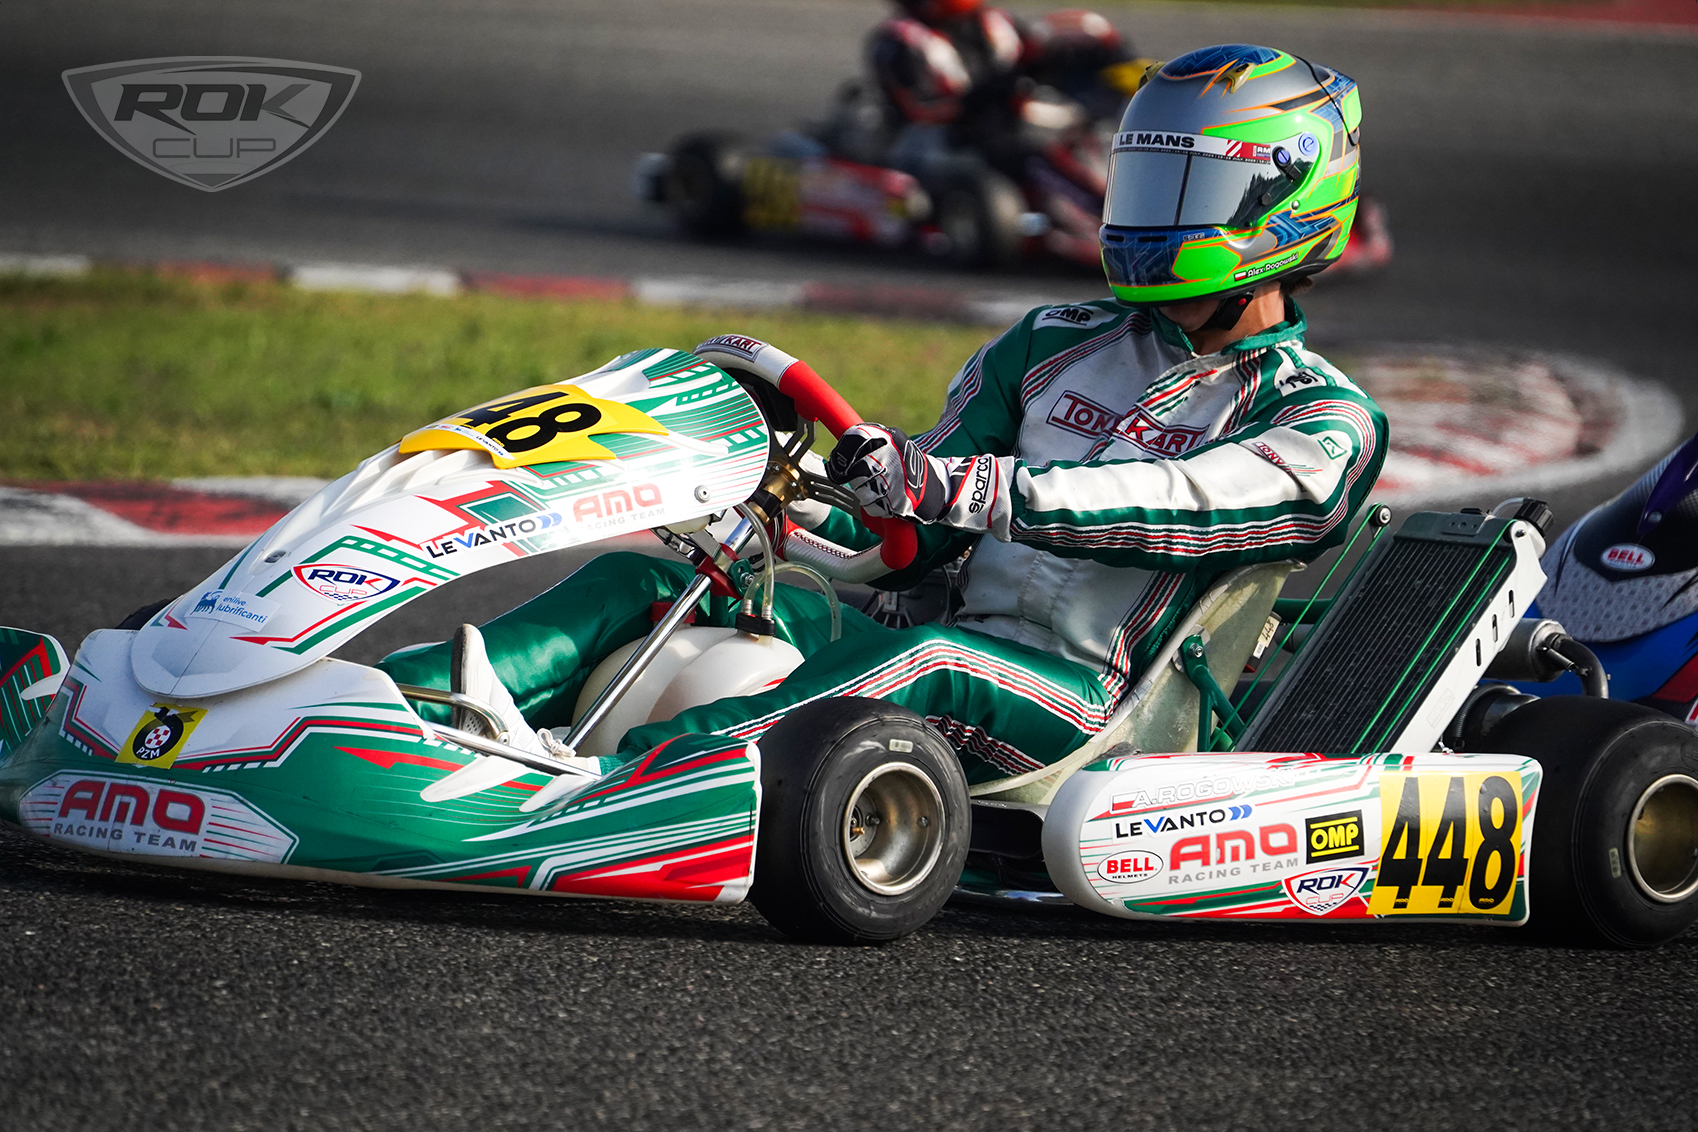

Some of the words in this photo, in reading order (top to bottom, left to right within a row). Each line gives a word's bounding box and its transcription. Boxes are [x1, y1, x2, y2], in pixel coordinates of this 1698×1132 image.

[1119, 133, 1133, 146] LE
[1137, 133, 1195, 149] MANS
[1248, 268, 1264, 277] Alex
[1265, 251, 1299, 271] Rogowski
[1045, 307, 1091, 323] OMP
[968, 457, 990, 514] sparco
[573, 483, 662, 522] AMO
[581, 516, 625, 531] ACING
[631, 508, 665, 521] TEAM
[426, 518, 537, 558] LEVANTO
[1607, 548, 1644, 566] BELL
[308, 568, 384, 592] ROK
[318, 585, 367, 596] CUP
[223, 595, 247, 606] enilive
[215, 604, 268, 624] lubrificanti
[136, 747, 160, 759] PZM
[58, 779, 205, 835] AMO
[1115, 808, 1226, 839] LEVANTO
[1310, 821, 1359, 848] OMP
[53, 823, 123, 841] RACING
[134, 830, 198, 851] TEAM
[1169, 823, 1298, 870] AMO
[1376, 775, 1520, 910] 448
[1107, 856, 1154, 874] BELL
[1112, 872, 1148, 880] HELMETS
[1168, 866, 1242, 885] RACING
[1250, 858, 1298, 874] TEAM
[1297, 874, 1358, 897] ROK
[1305, 893, 1345, 906] CUP
